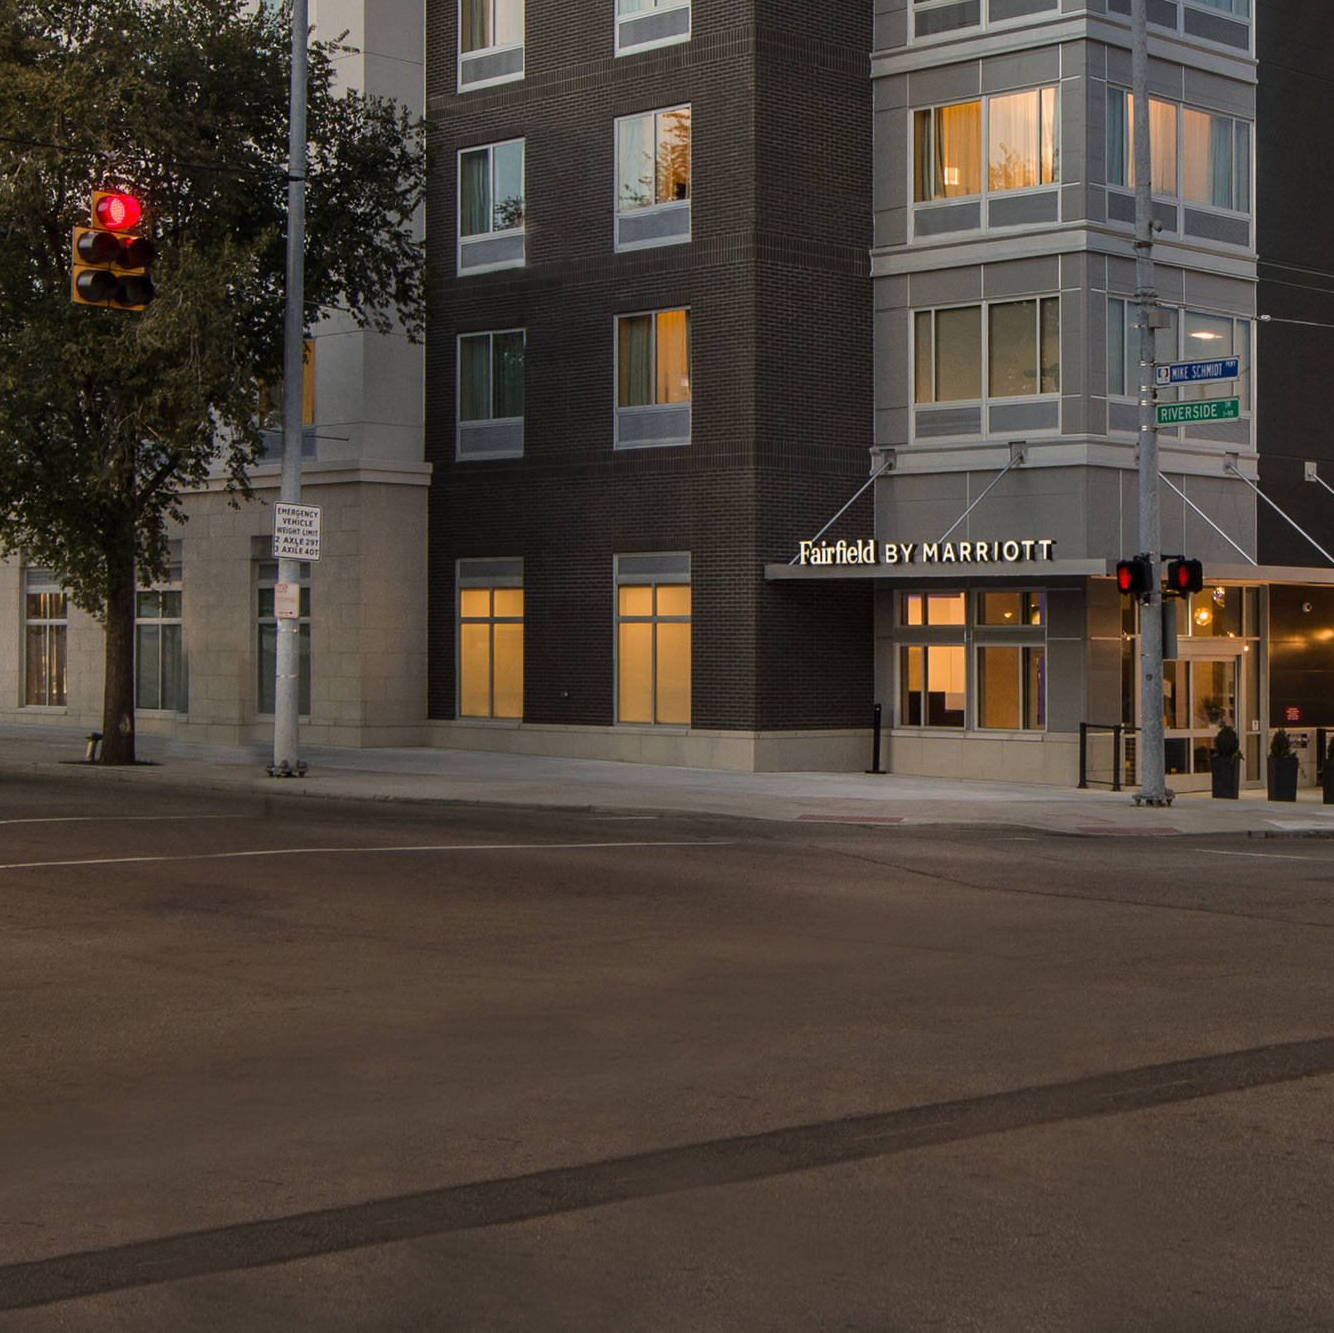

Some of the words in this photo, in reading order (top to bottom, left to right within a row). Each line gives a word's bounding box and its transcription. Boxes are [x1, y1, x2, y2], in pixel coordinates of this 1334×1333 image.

[1171, 365, 1188, 381] MIKE
[1192, 362, 1223, 379] SCHMIDT
[1161, 404, 1217, 421] RIVERSIDE
[277, 507, 318, 518] EMERGENCY
[282, 518, 313, 527] VEHICLE
[283, 537, 304, 545] AXLE
[799, 539, 876, 565] Fairfield
[885, 543, 914, 563] BY
[922, 539, 1053, 563] MARRIOTT
